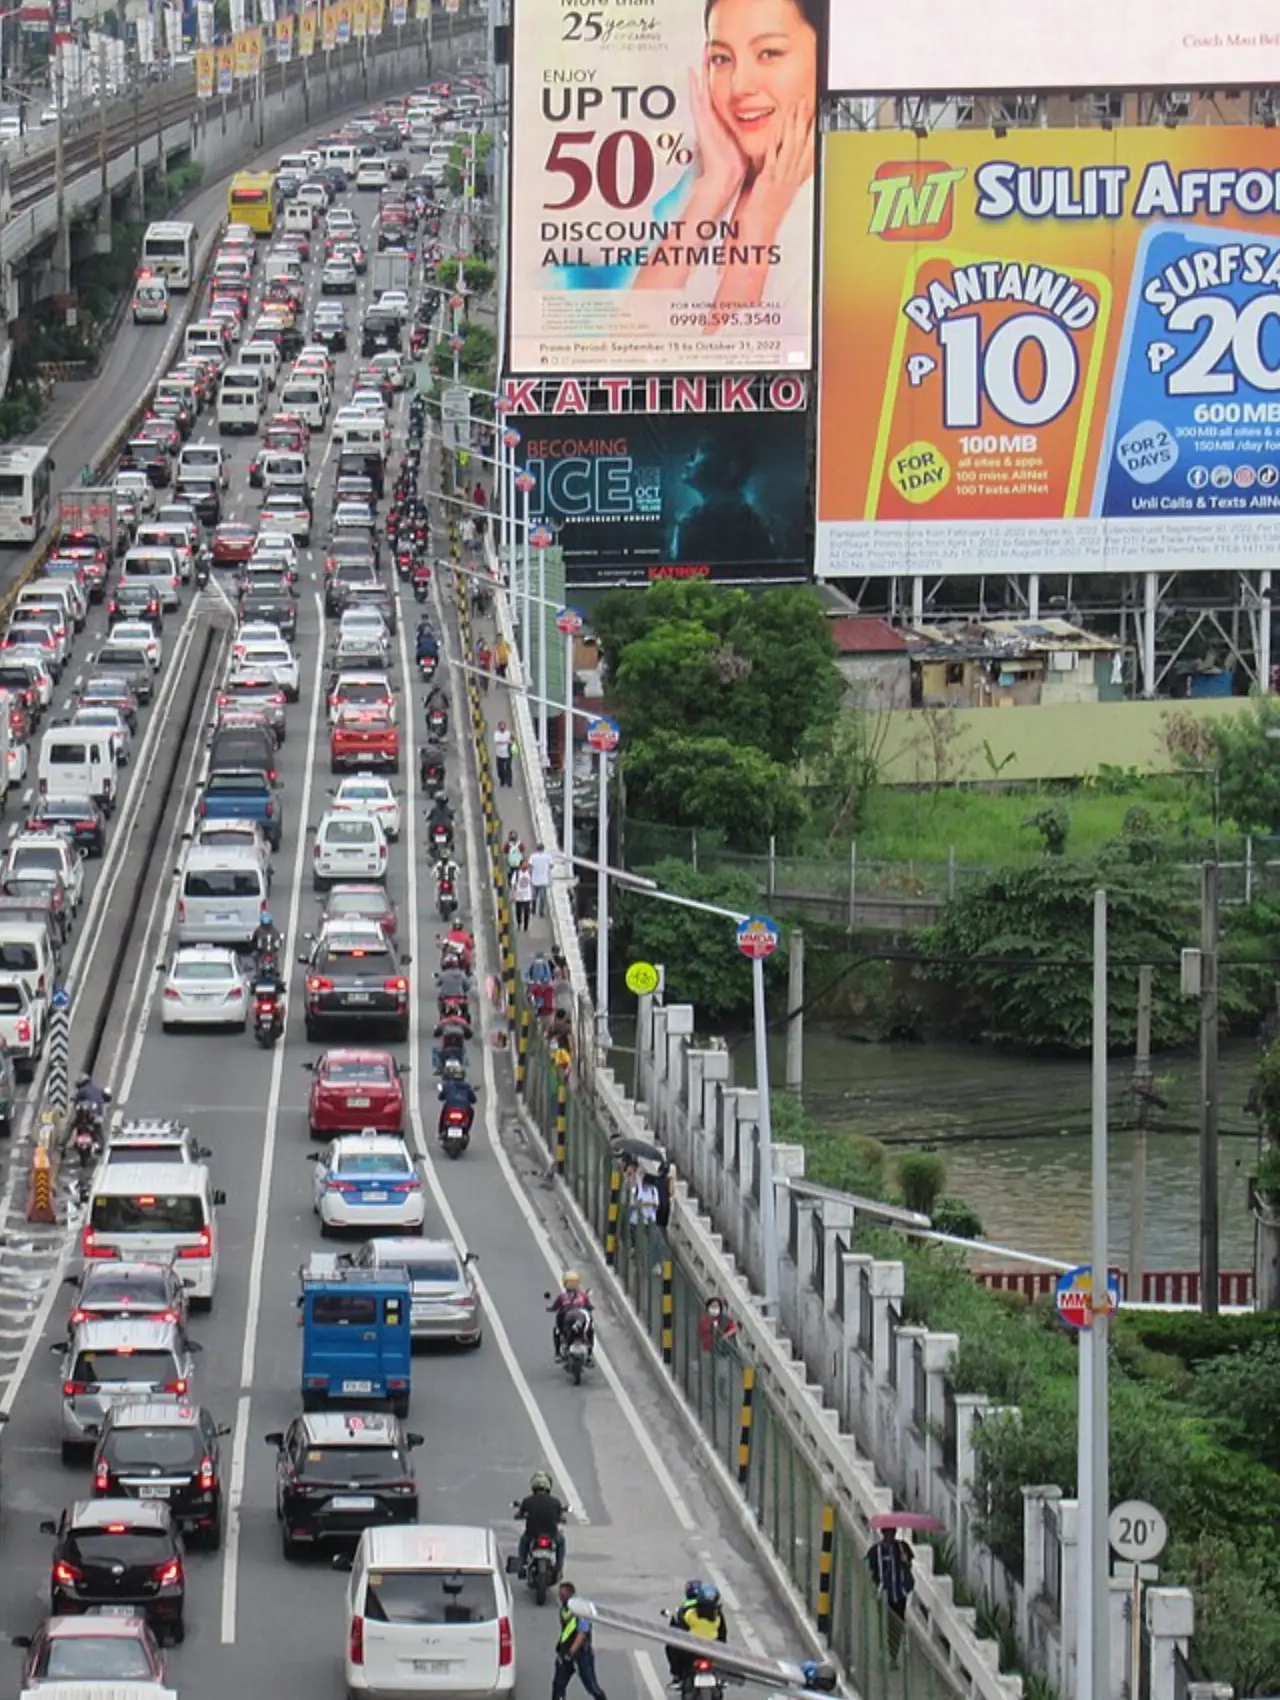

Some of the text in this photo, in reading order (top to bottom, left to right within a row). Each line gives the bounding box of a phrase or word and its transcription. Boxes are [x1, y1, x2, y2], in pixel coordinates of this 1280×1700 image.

[561, 11, 603, 42] 25
[1182, 34, 1223, 48] Coach
[543, 69, 597, 82] ENJOY
[542, 85, 677, 121] UP TO
[542, 129, 693, 210] 50%
[867, 166, 968, 236] TNT
[976, 161, 1280, 218] SULIT AFFO
[540, 220, 740, 242] DISCOUNT ON
[541, 245, 782, 267] ALL TREATMENTS
[903, 262, 1100, 333] PANTAWID
[670, 312, 781, 326] 0998.595.3540
[539, 343, 570, 352] Promo
[611, 342, 664, 353] September
[682, 342, 692, 350] to
[696, 341, 735, 350] October
[757, 341, 781, 350] 2022
[940, 312, 1080, 428] 10
[505, 374, 805, 414] KATINKO
[527, 438, 628, 458] BECOMING
[1120, 431, 1170, 457] FOR 2
[897, 452, 935, 474] FOR
[1126, 449, 1171, 472] DAYS
[526, 456, 634, 515] ICE
[635, 486, 659, 499] OCT
[1131, 496, 1158, 510] Unli
[1160, 496, 1193, 509] Calls
[1196, 497, 1206, 508] &
[1209, 497, 1247, 509] Texts
[1119, 1517, 1148, 1547] 20
